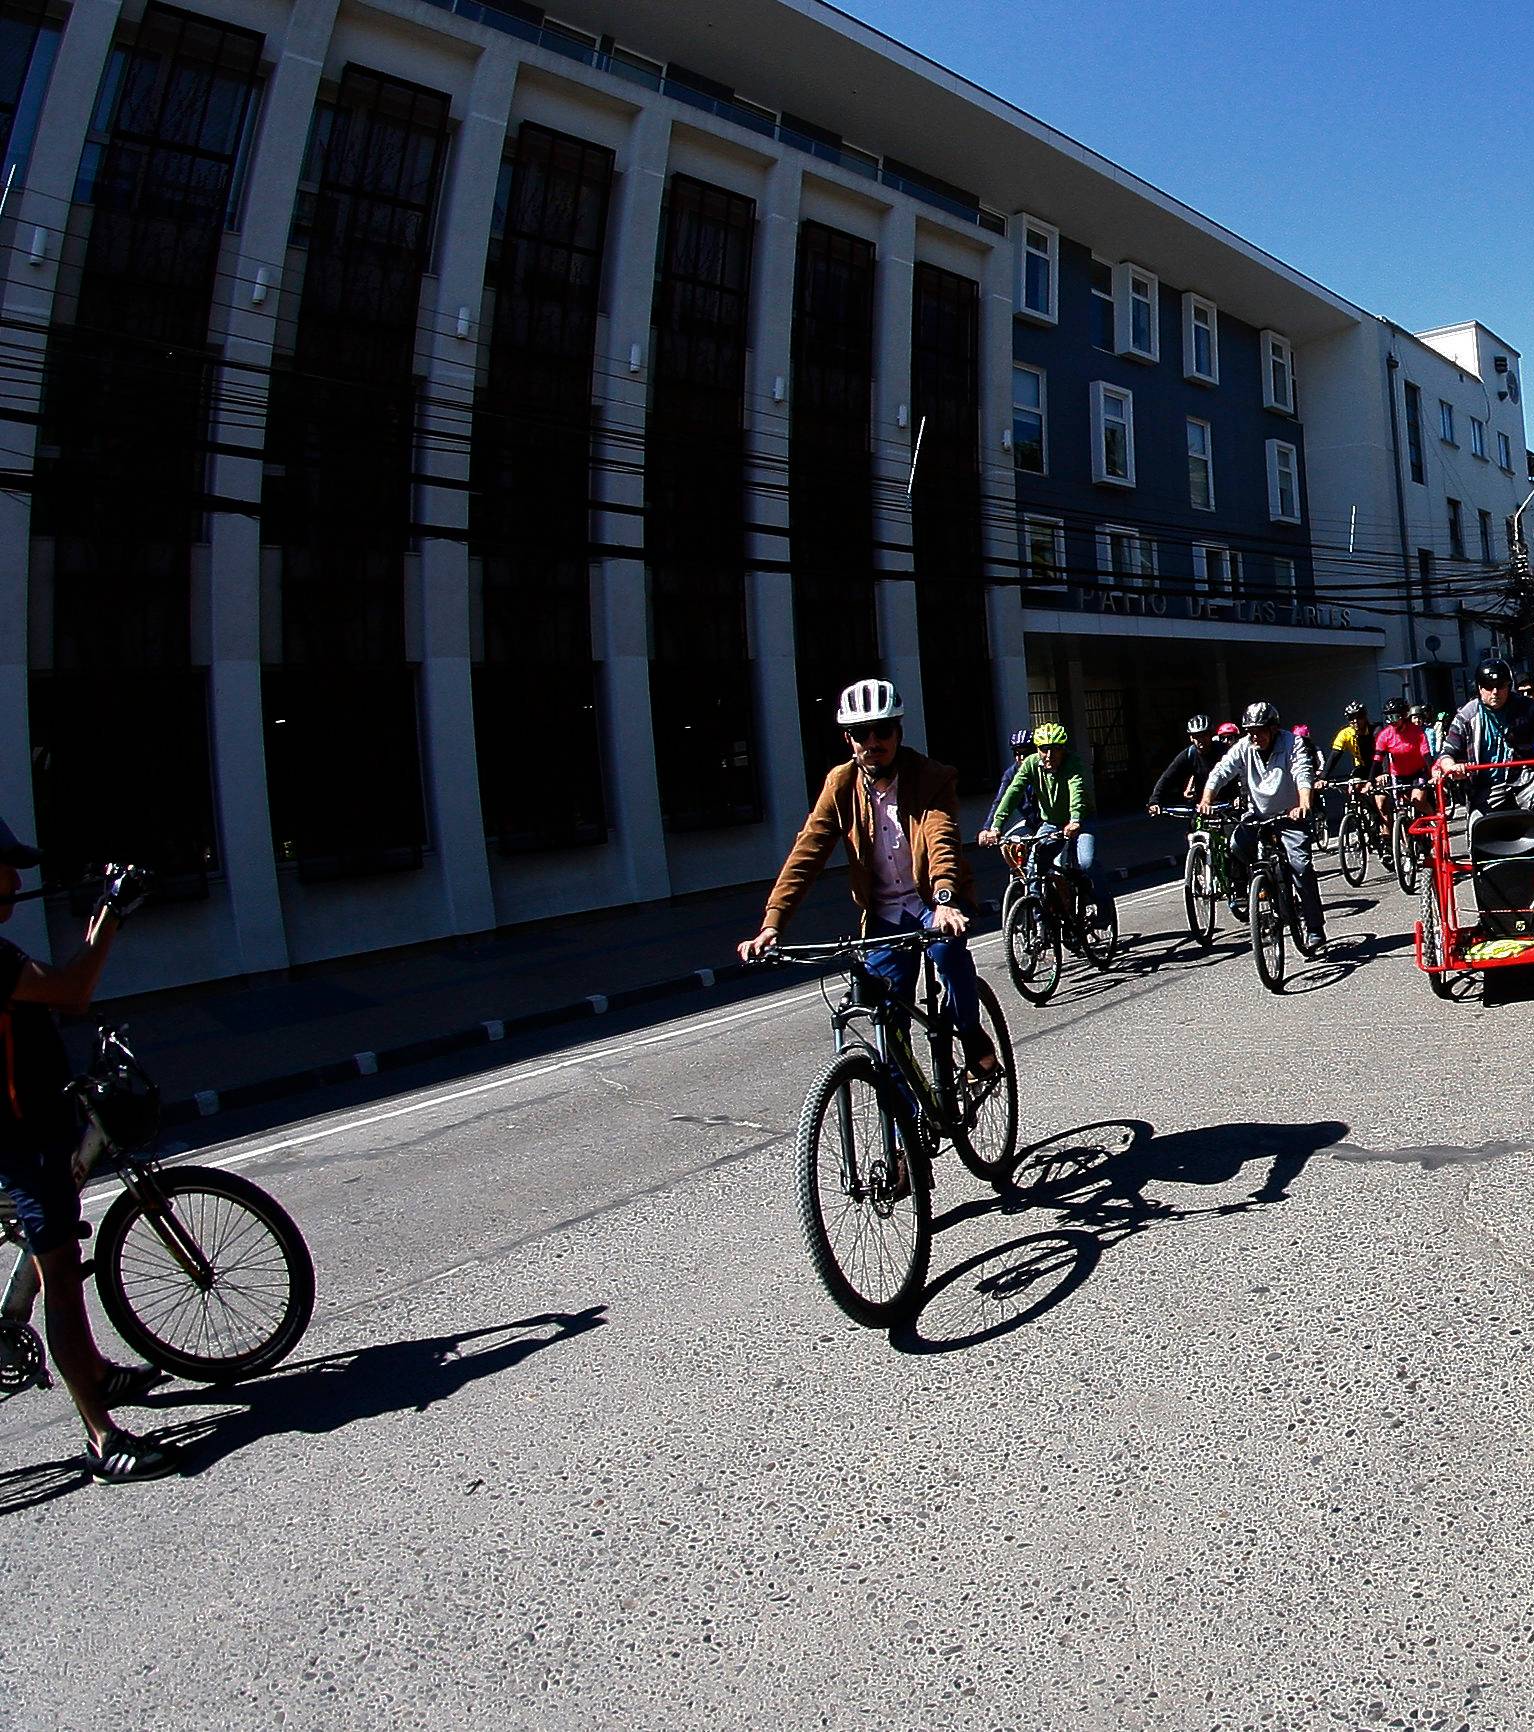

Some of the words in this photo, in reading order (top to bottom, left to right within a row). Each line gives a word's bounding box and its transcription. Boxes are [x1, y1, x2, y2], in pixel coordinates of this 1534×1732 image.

[1079, 587, 1168, 615] PATIO
[1233, 599, 1277, 623] LAS
[1291, 602, 1352, 629] ARTES
